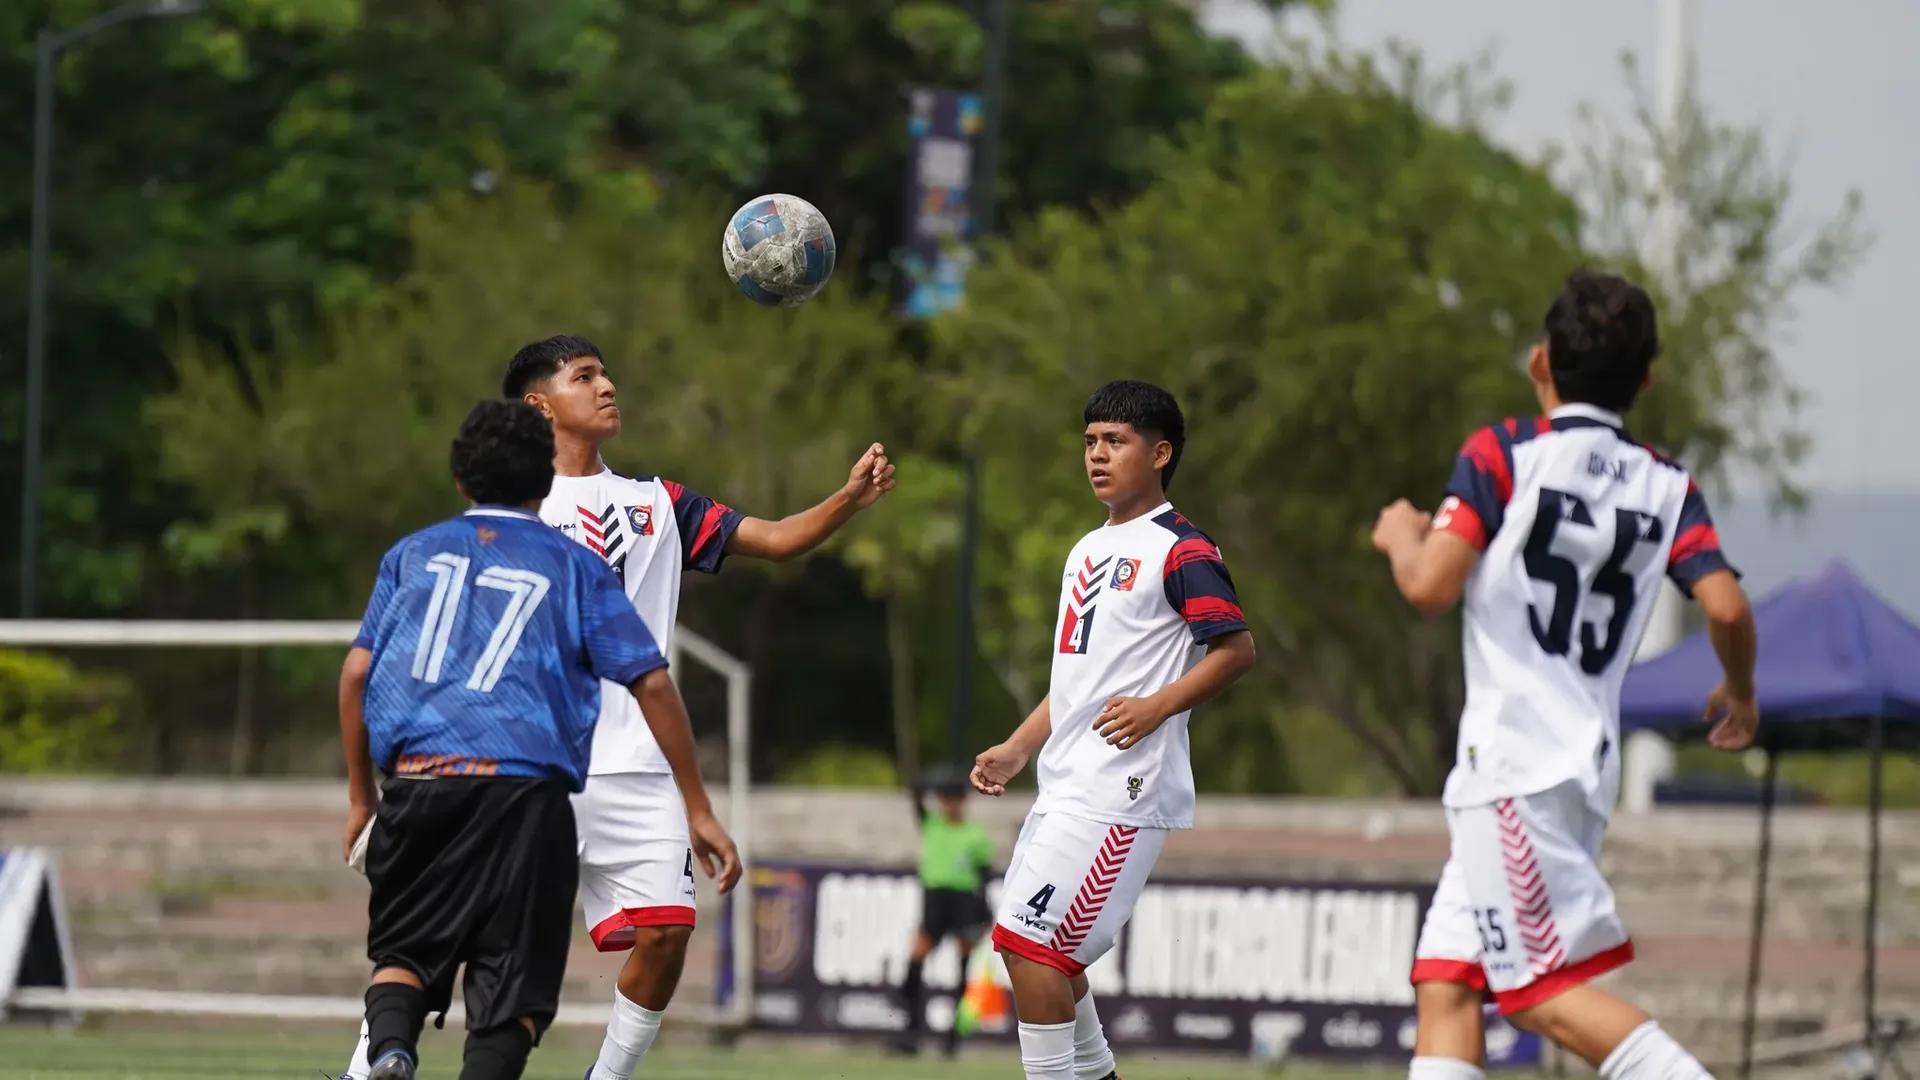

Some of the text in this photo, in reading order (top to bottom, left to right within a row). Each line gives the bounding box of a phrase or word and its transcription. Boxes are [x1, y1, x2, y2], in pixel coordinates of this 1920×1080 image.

[412, 552, 551, 693] 17
[1523, 487, 1663, 676] 55
[1068, 618, 1085, 652] 4
[1027, 883, 1056, 918] 4
